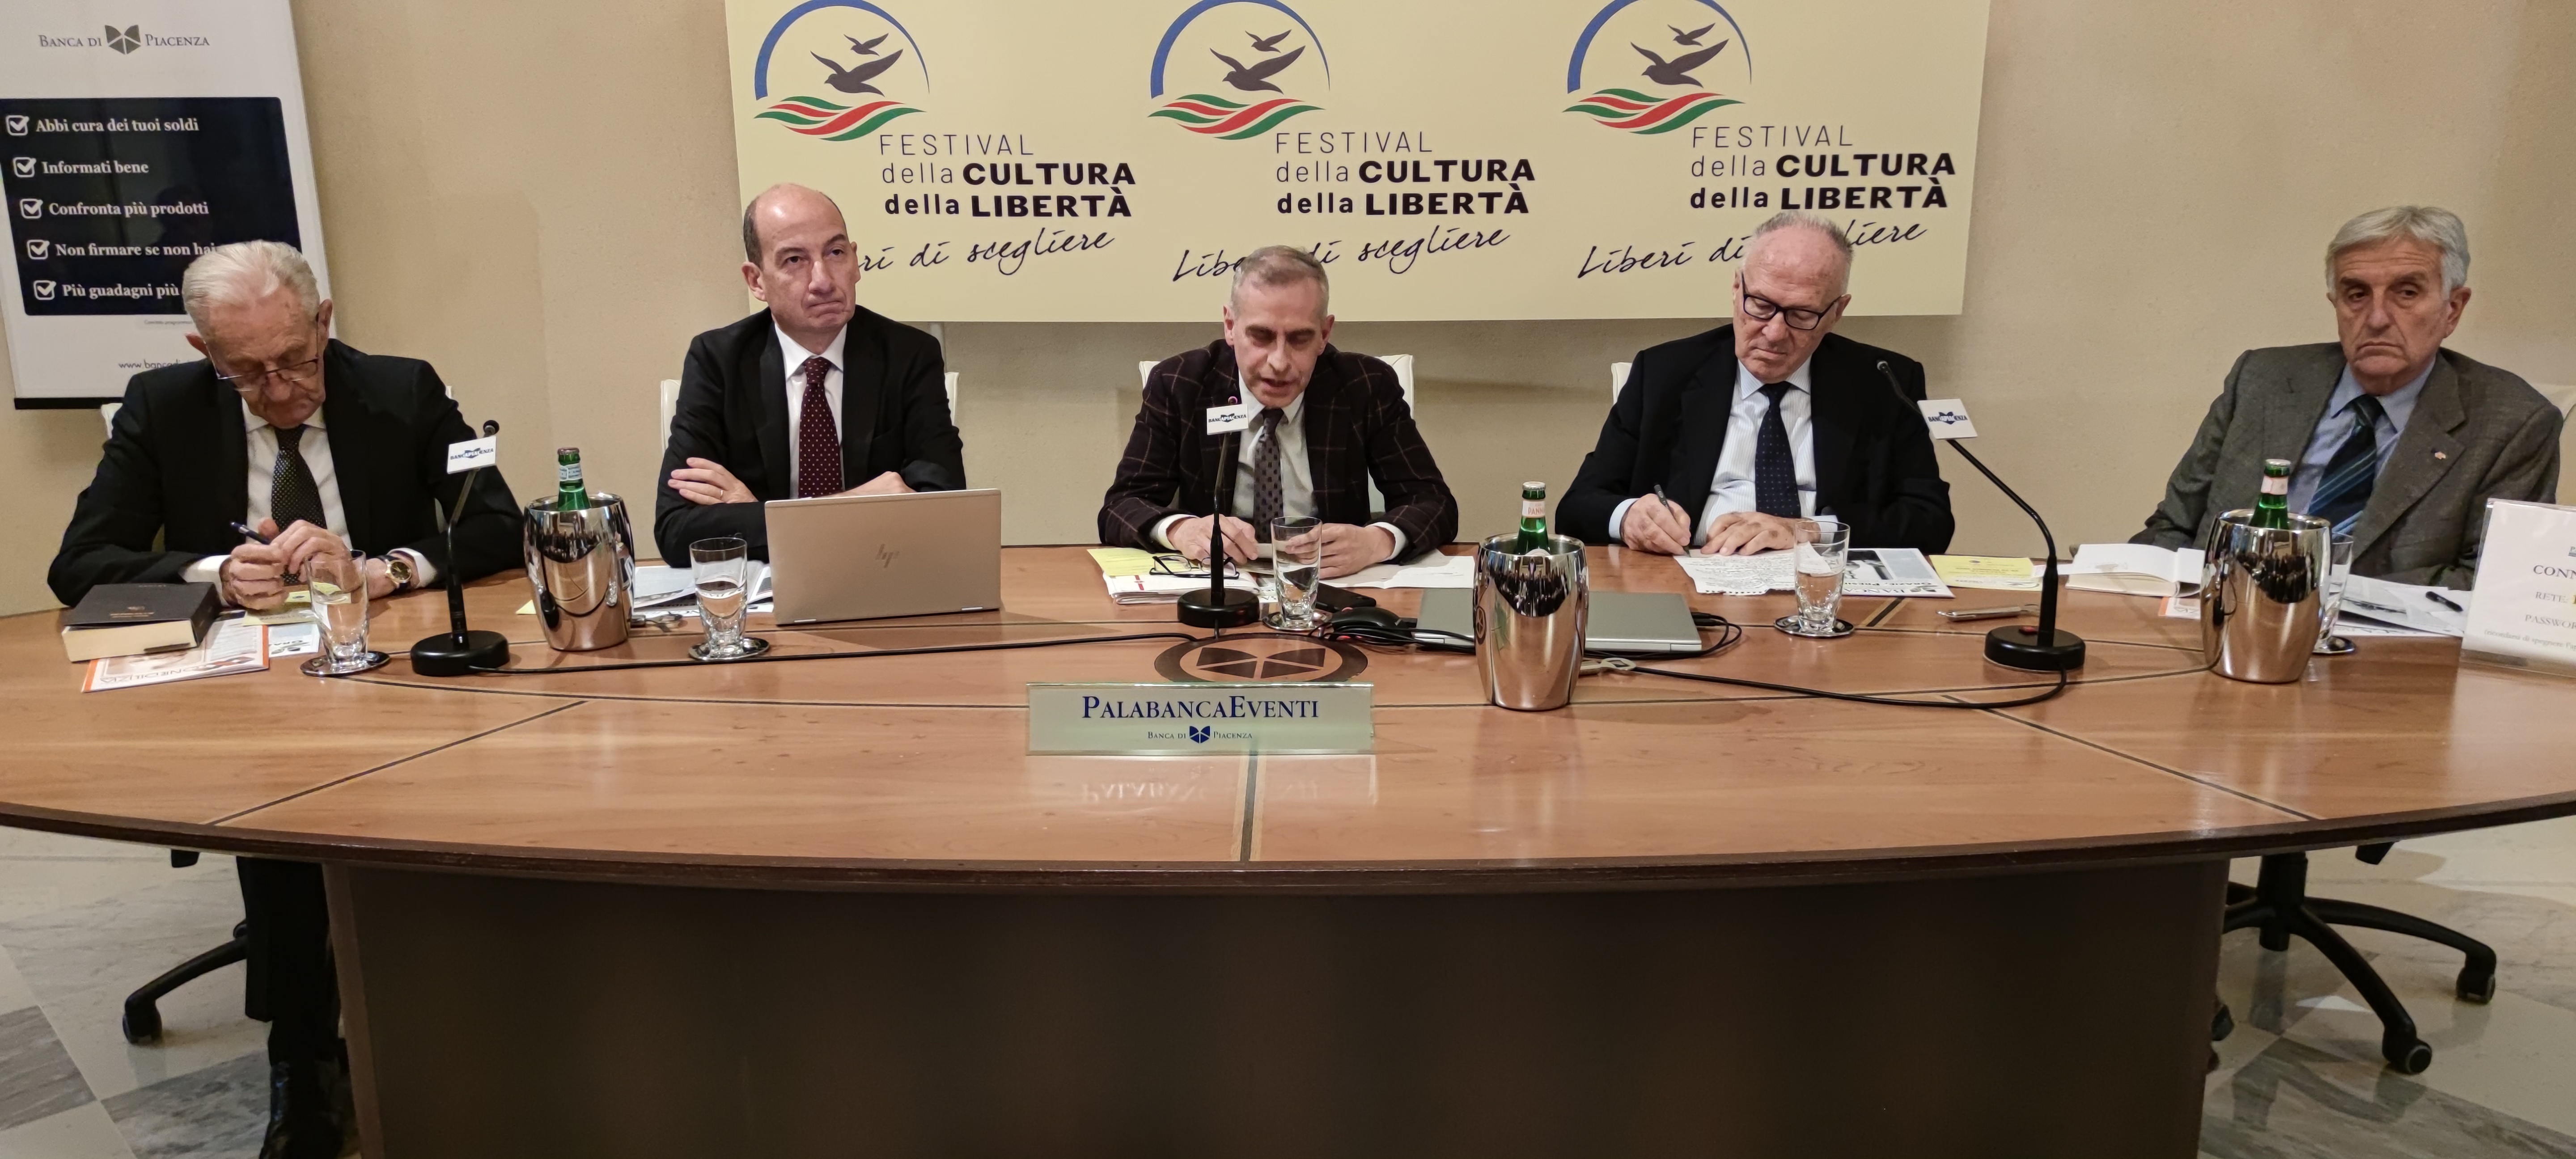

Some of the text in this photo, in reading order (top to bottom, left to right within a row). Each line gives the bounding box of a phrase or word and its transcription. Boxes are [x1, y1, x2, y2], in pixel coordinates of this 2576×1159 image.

[38, 34, 210, 47] BANCA DI PIACENZA
[36, 118, 199, 132] Abbi cura dei tuoi soldi
[1693, 125, 1853, 148] FESTIVAL
[880, 134, 1034, 156] FESTIVAL
[1276, 131, 1432, 154] FESTIVAL
[42, 161, 148, 173] Informati bene
[882, 162, 1135, 185] della CULTURA
[1276, 159, 1535, 184] della CULTURA
[1691, 152, 1955, 178] della CULTURA
[885, 184, 1131, 217] della LIBERTÀ
[1277, 183, 1529, 216] della LIBERTÀ
[1690, 176, 1947, 210] della LIBERTÀ
[49, 201, 209, 218] Confronta più prodotti
[55, 242, 215, 256] Non firmare se non hai
[909, 241, 950, 267] di
[967, 227, 1115, 276] scegliere
[1358, 225, 1510, 275] scegliere
[1577, 241, 1695, 279] Liberi
[1707, 236, 1750, 263] di
[62, 283, 180, 300] Più guadagni più
[1082, 695, 1318, 718] PALABANCAEVENTI
[1148, 731, 1174, 739] BANCA
[1213, 731, 1253, 739] PIACENZA
